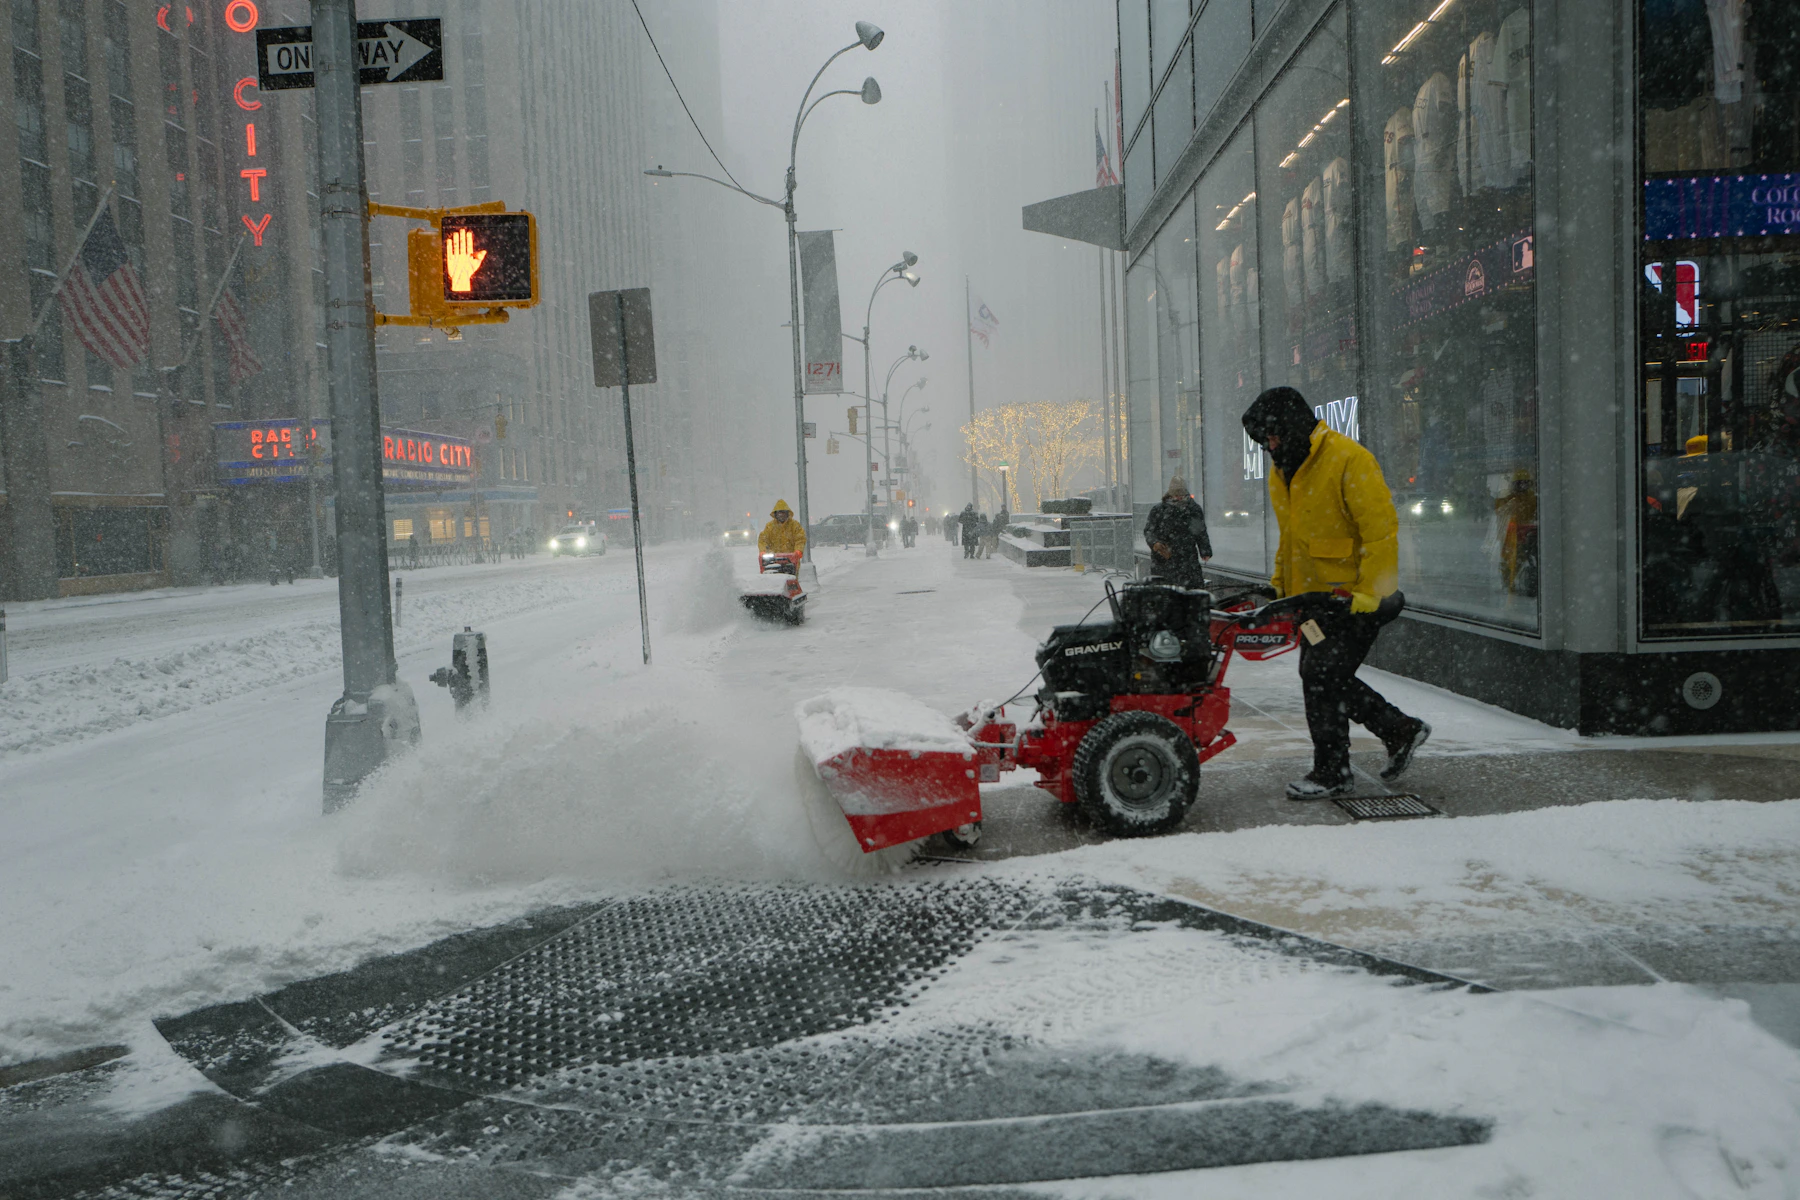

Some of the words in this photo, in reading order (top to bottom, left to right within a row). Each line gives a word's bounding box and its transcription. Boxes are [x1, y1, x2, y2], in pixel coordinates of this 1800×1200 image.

[277, 45, 314, 71] ON
[234, 77, 272, 247] CITY
[383, 435, 433, 464] RADIO
[440, 443, 471, 467] CITY
[1065, 641, 1123, 657] GRAVELY
